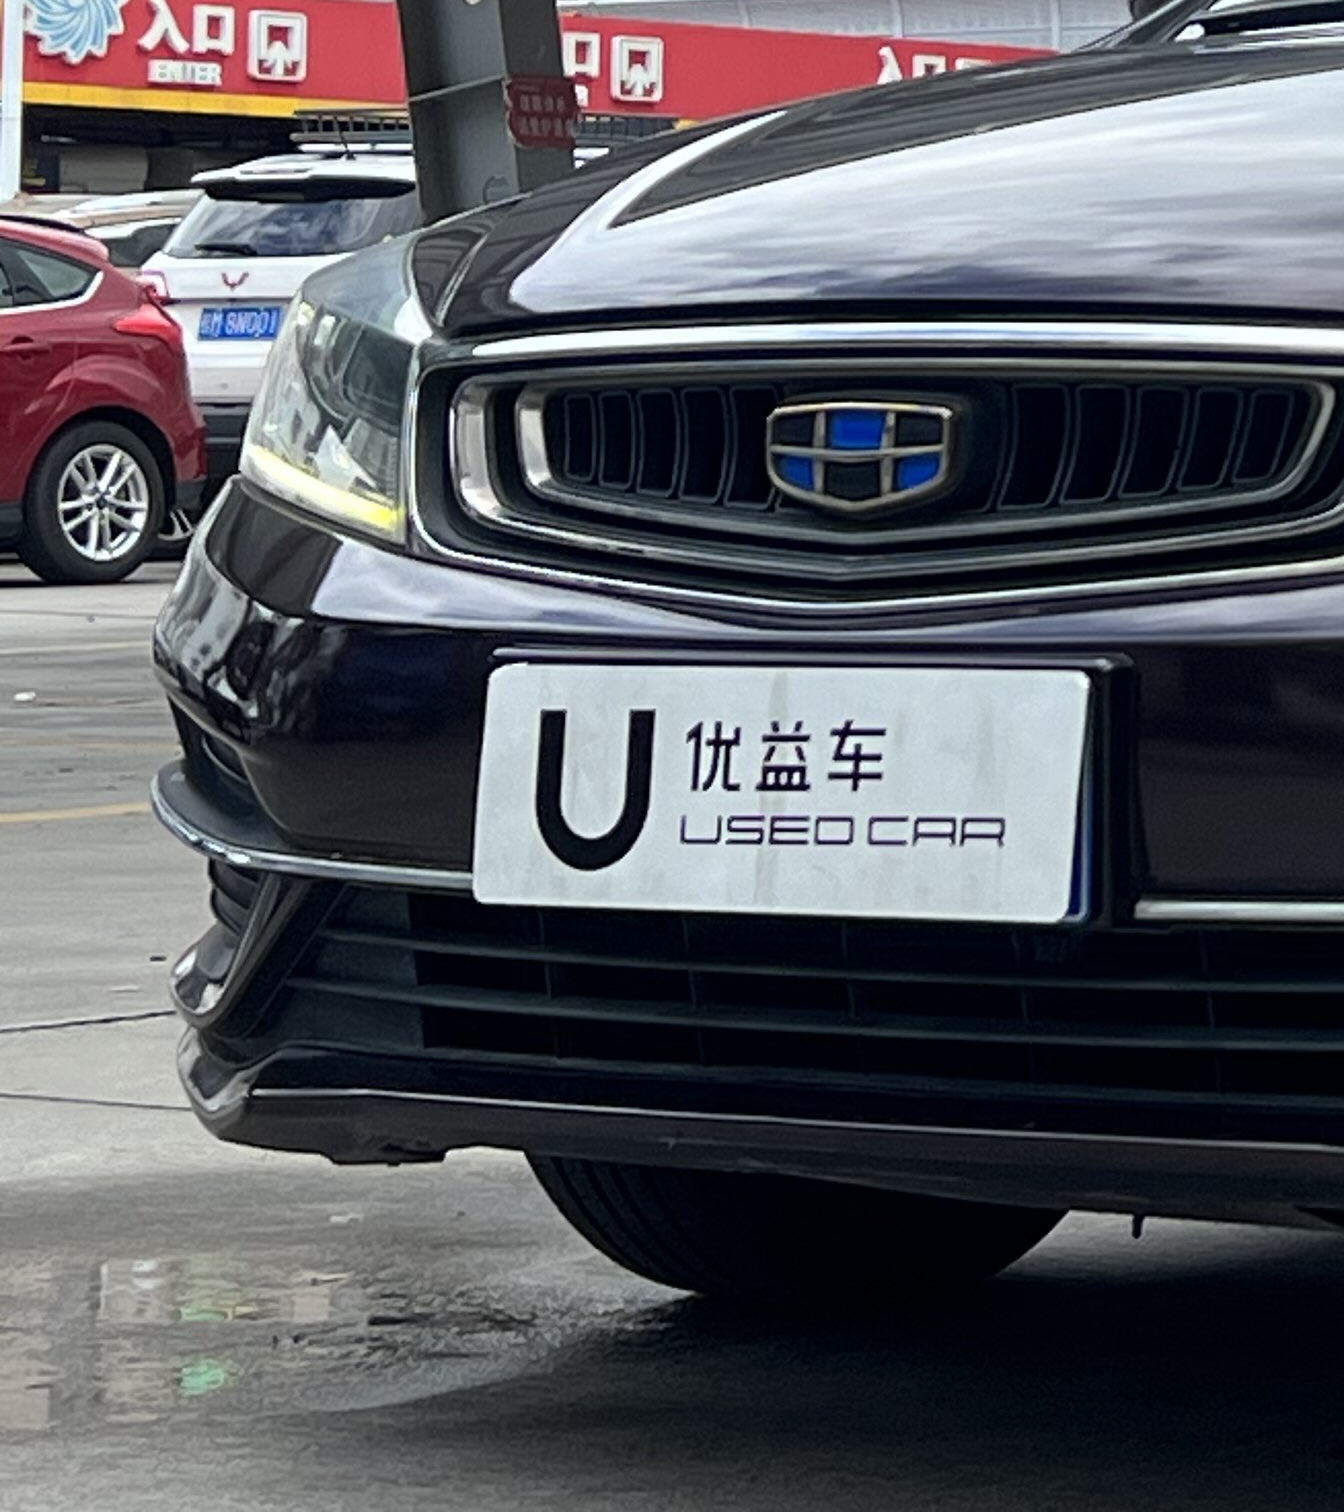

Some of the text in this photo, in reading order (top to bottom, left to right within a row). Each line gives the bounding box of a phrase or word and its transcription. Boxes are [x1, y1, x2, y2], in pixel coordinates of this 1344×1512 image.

[534, 708, 656, 871] U
[686, 719, 887, 791] 优益车
[679, 814, 1006, 849] USED CAR
